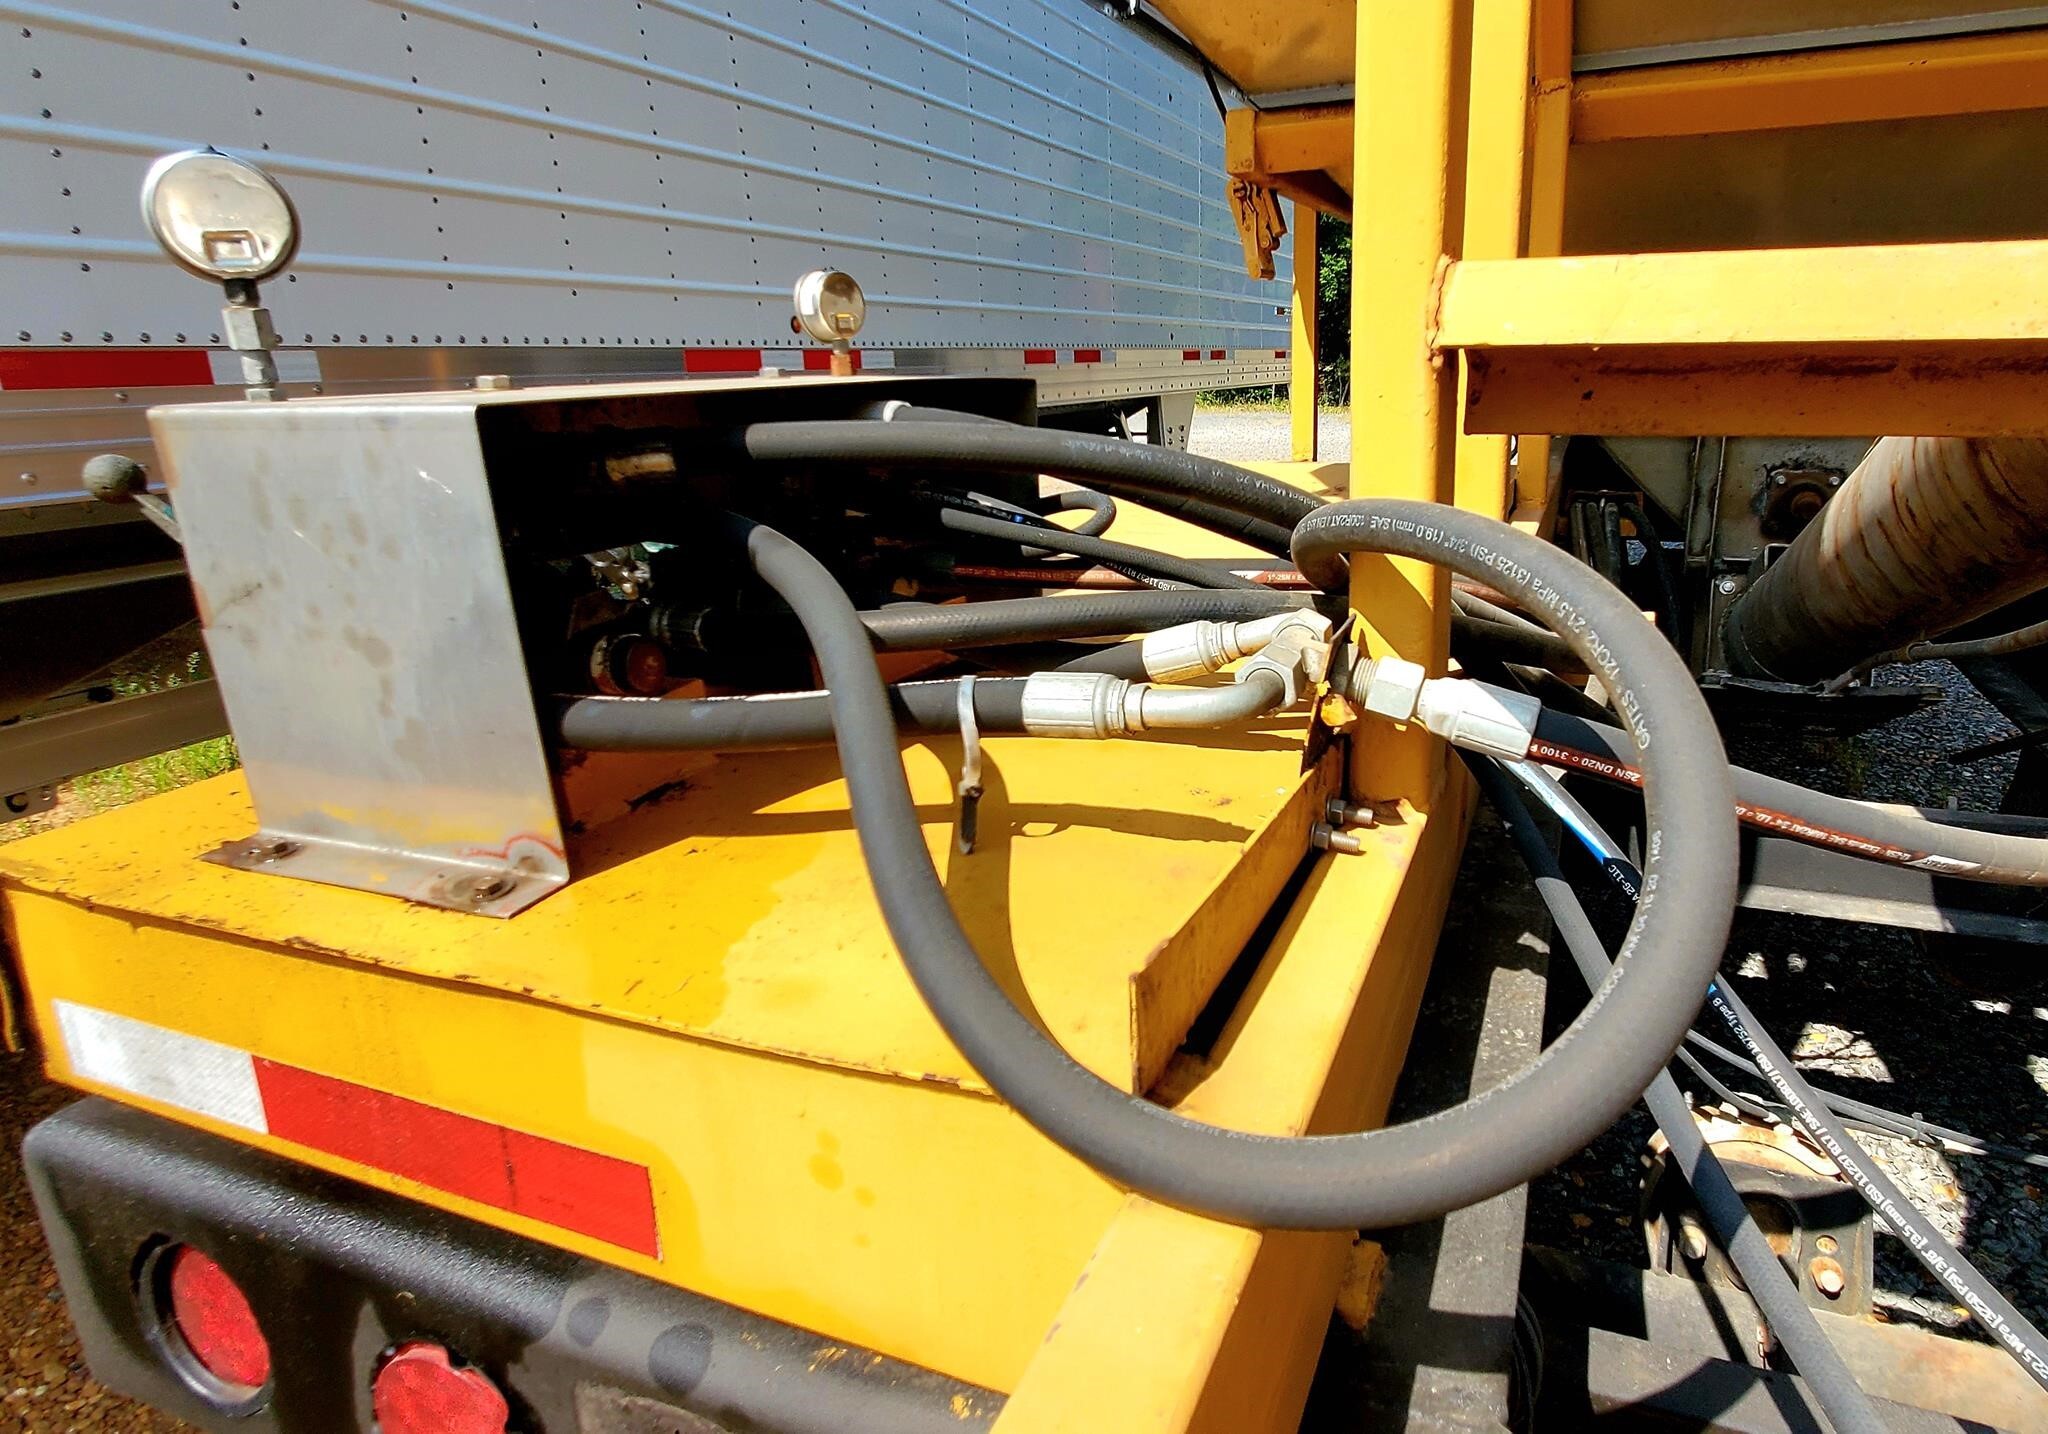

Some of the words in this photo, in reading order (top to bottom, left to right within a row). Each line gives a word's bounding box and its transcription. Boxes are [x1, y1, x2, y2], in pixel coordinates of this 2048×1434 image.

[1370, 515, 1390, 527] SAE
[1392, 518, 1415, 531] mm)
[1415, 524, 1443, 543] (19.0
[1468, 543, 1496, 564] PSI)
[1495, 554, 1531, 582] (3125
[1529, 577, 1560, 608] MPa
[1557, 600, 1586, 633] 21.5
[1540, 745, 1568, 759] 3100
[1580, 757, 1613, 772] DN20
[1614, 767, 1641, 781] 2SN
[1828, 833, 1847, 845] SAE
[1607, 863, 1635, 895] 2G-11C
[1711, 995, 1723, 1007] B
[1717, 1003, 1737, 1027] Type
[1732, 1023, 1761, 1056] 18752
[1799, 1108, 1821, 1130] SAE
[1820, 1132, 1843, 1156] R17
[1836, 1152, 1869, 1187] 11237
[1863, 1181, 1884, 1203] ISO
[1878, 1198, 1906, 1228] mm)
[1940, 1265, 1969, 1294] PSI)
[1963, 1289, 2003, 1328] (3250
[1996, 1322, 2026, 1352] MPa
